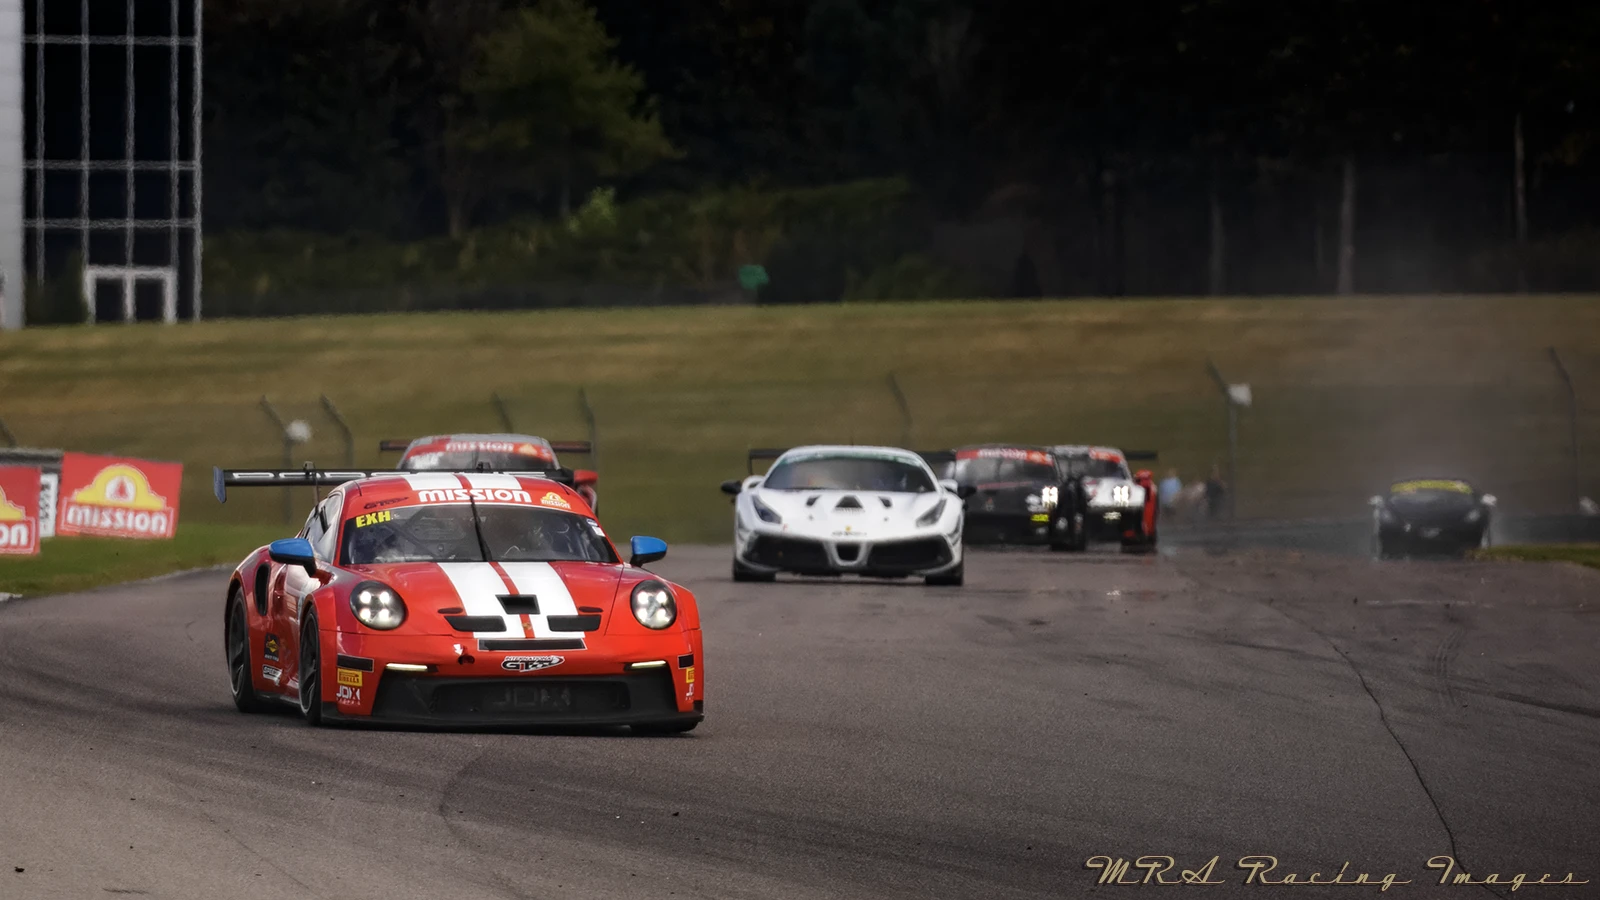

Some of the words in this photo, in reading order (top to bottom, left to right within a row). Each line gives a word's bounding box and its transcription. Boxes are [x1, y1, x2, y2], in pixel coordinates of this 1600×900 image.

[418, 489, 532, 503] MISSION
[66, 504, 168, 534] MISSION
[355, 510, 391, 528] EXH
[336, 685, 361, 701] JDX
